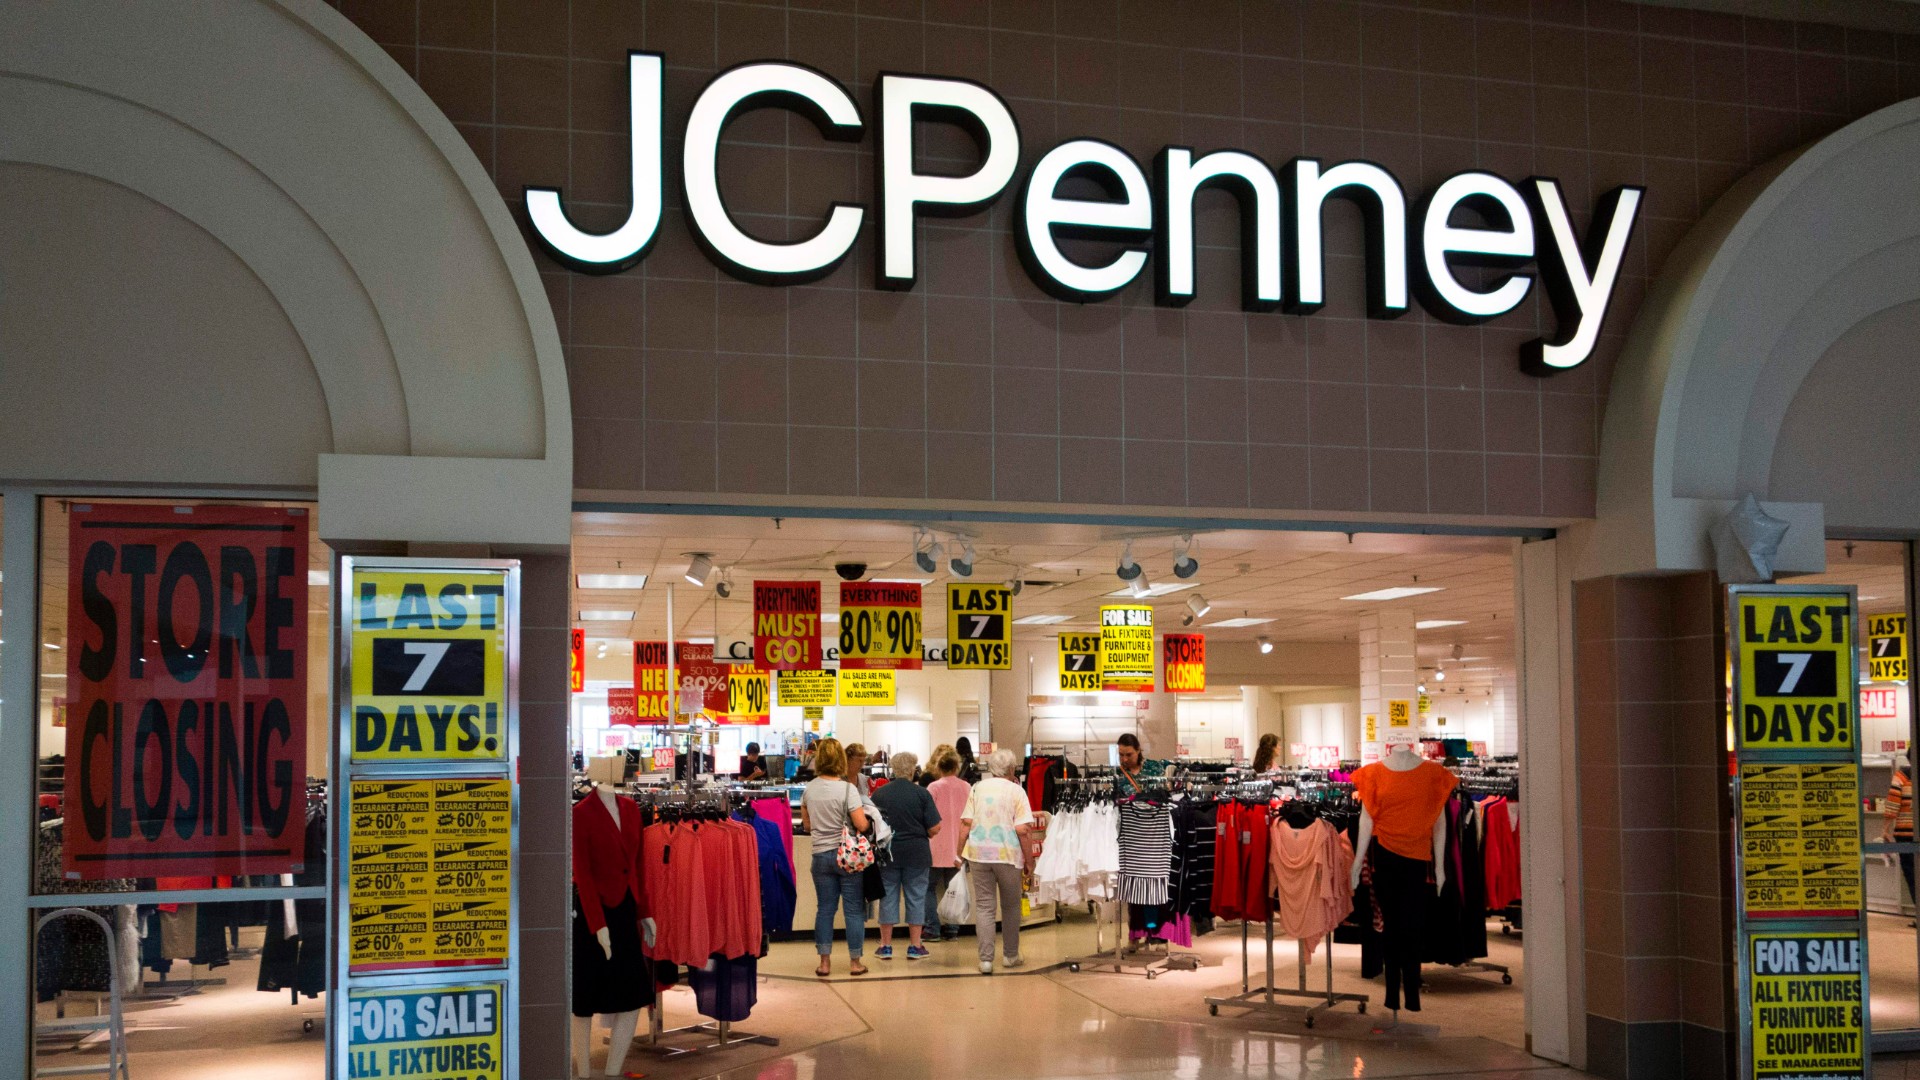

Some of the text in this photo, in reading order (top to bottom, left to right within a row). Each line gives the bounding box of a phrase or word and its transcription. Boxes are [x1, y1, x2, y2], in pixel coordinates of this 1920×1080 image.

[526, 53, 1640, 369] JCPenney
[755, 587, 817, 611] EVERYTHING
[842, 589, 918, 603] EVERYTHING
[952, 589, 1011, 611] LAST
[79, 541, 295, 684] STORE
[360, 582, 504, 630] LAST
[757, 613, 817, 637] MUST
[1102, 609, 1152, 626] FOR SALE
[1744, 605, 1850, 643] LAST
[839, 609, 882, 655] 80%
[873, 641, 882, 651] TO
[970, 615, 990, 638] 7
[1868, 617, 1906, 636] LAST
[1102, 629, 1152, 641] ALL FIXTURES,
[765, 639, 809, 664] GO!
[1061, 636, 1101, 651] LAST
[1104, 641, 1152, 651] FURNITURE &
[1166, 637, 1203, 663] STORE
[1876, 638, 1890, 657] 7
[951, 643, 1009, 666] DAYS!
[1108, 653, 1149, 663] EQUIPMENT
[401, 642, 451, 691] 7
[1072, 655, 1086, 671] 7
[1870, 659, 1907, 678] DAYS!
[1166, 664, 1204, 689] CLOSING
[1777, 653, 1812, 693] 7
[682, 676, 727, 692] 80%
[1061, 674, 1100, 689] DAYS!
[1860, 690, 1895, 717] SALE
[355, 702, 498, 752] DAYS!
[1745, 702, 1848, 743] DAYS!
[80, 697, 292, 842] CLOSING
[437, 783, 465, 791] NEW!
[1758, 791, 1780, 803] 60%
[1816, 790, 1838, 802] 60%
[354, 803, 428, 812] CLEARANCE APPAREL
[436, 802, 508, 810] CLEARANCE APPAREL
[376, 814, 406, 829] 60%
[457, 812, 486, 827] 60%
[435, 843, 464, 851] NEW!
[1759, 839, 1781, 852] 60%
[1818, 839, 1839, 851] 60%
[352, 863, 427, 873] CLEARANCE APPAREL
[434, 861, 507, 870] CLEARANCE APPAREL
[375, 874, 404, 890] 60%
[456, 872, 485, 887] 60%
[1760, 888, 1782, 900] 60%
[1820, 888, 1841, 900] 60%
[353, 906, 381, 914] NEW!
[435, 902, 463, 910] NEW!
[353, 924, 426, 934] CLEARANCE APPAREL
[434, 921, 506, 930] CLEARANCE APPAREL
[374, 935, 403, 950] 60%
[456, 932, 484, 947] 60%
[1756, 940, 1860, 973] FOR SALE
[1755, 981, 1782, 1002] ALL
[349, 993, 493, 1042] FOR SALE
[1759, 1005, 1862, 1029] FURNITURE &
[1766, 1032, 1857, 1055] EQUIPMENT
[389, 1042, 497, 1076] FIXTURES,
[1757, 1057, 1863, 1069] SEE MANAGEMEN
